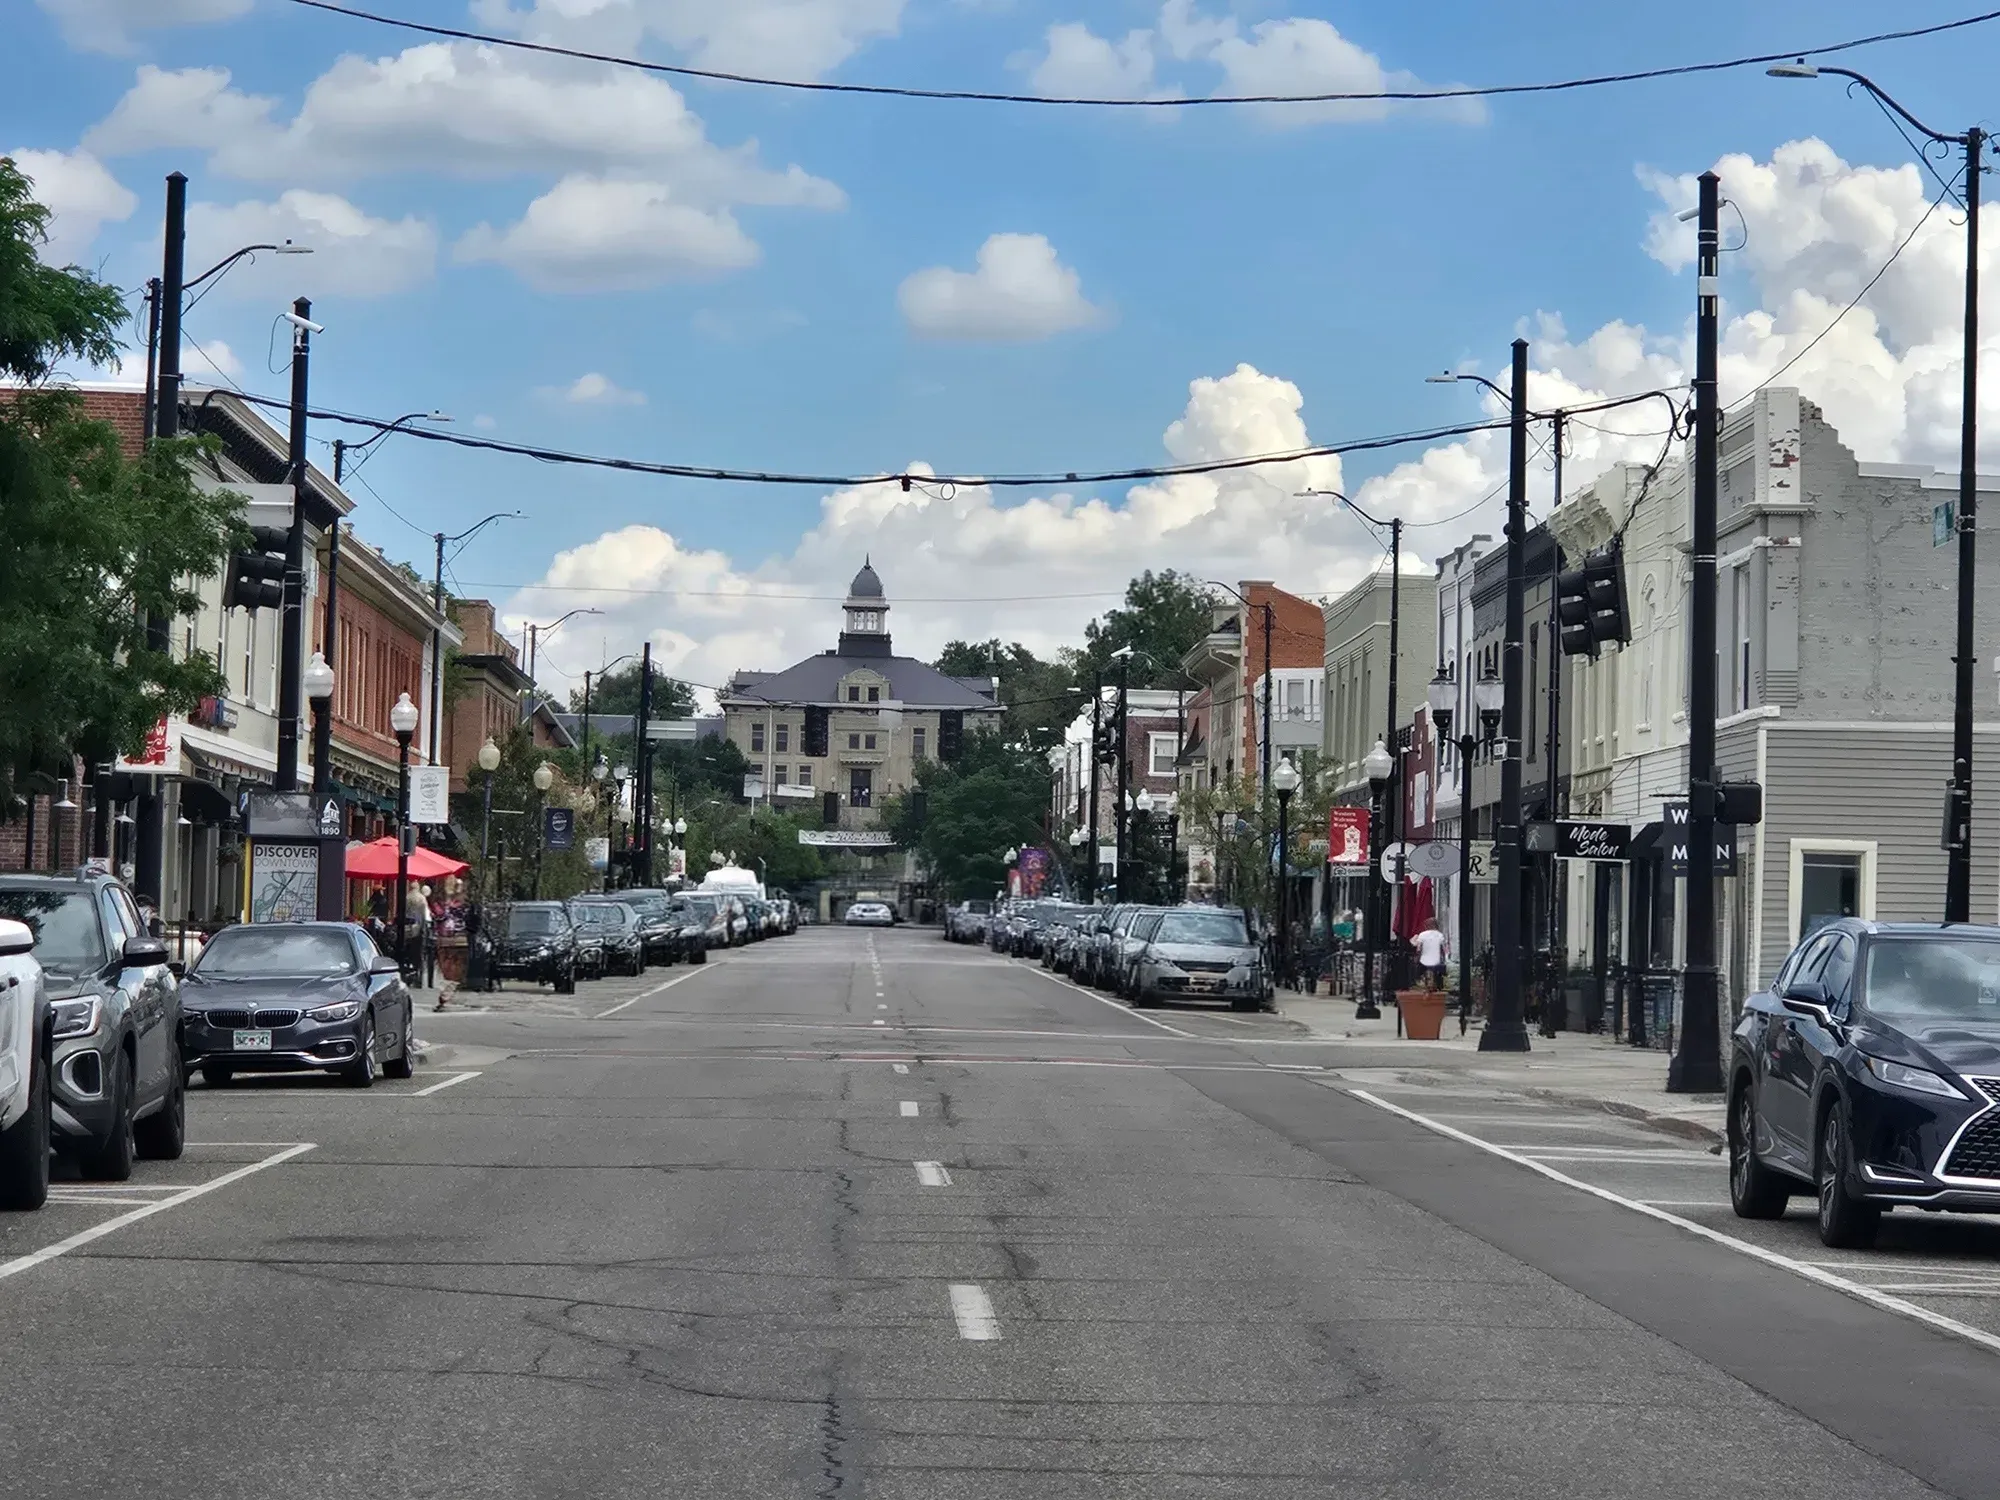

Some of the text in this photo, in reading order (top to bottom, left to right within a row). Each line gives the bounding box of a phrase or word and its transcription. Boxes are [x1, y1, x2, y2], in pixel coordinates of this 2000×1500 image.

[321, 827, 340, 835] 1890
[1569, 826, 1609, 840] Mode
[255, 846, 317, 858] DISCOVER
[1576, 840, 1620, 857] Salon
[255, 858, 317, 868] DOWNTOWN
